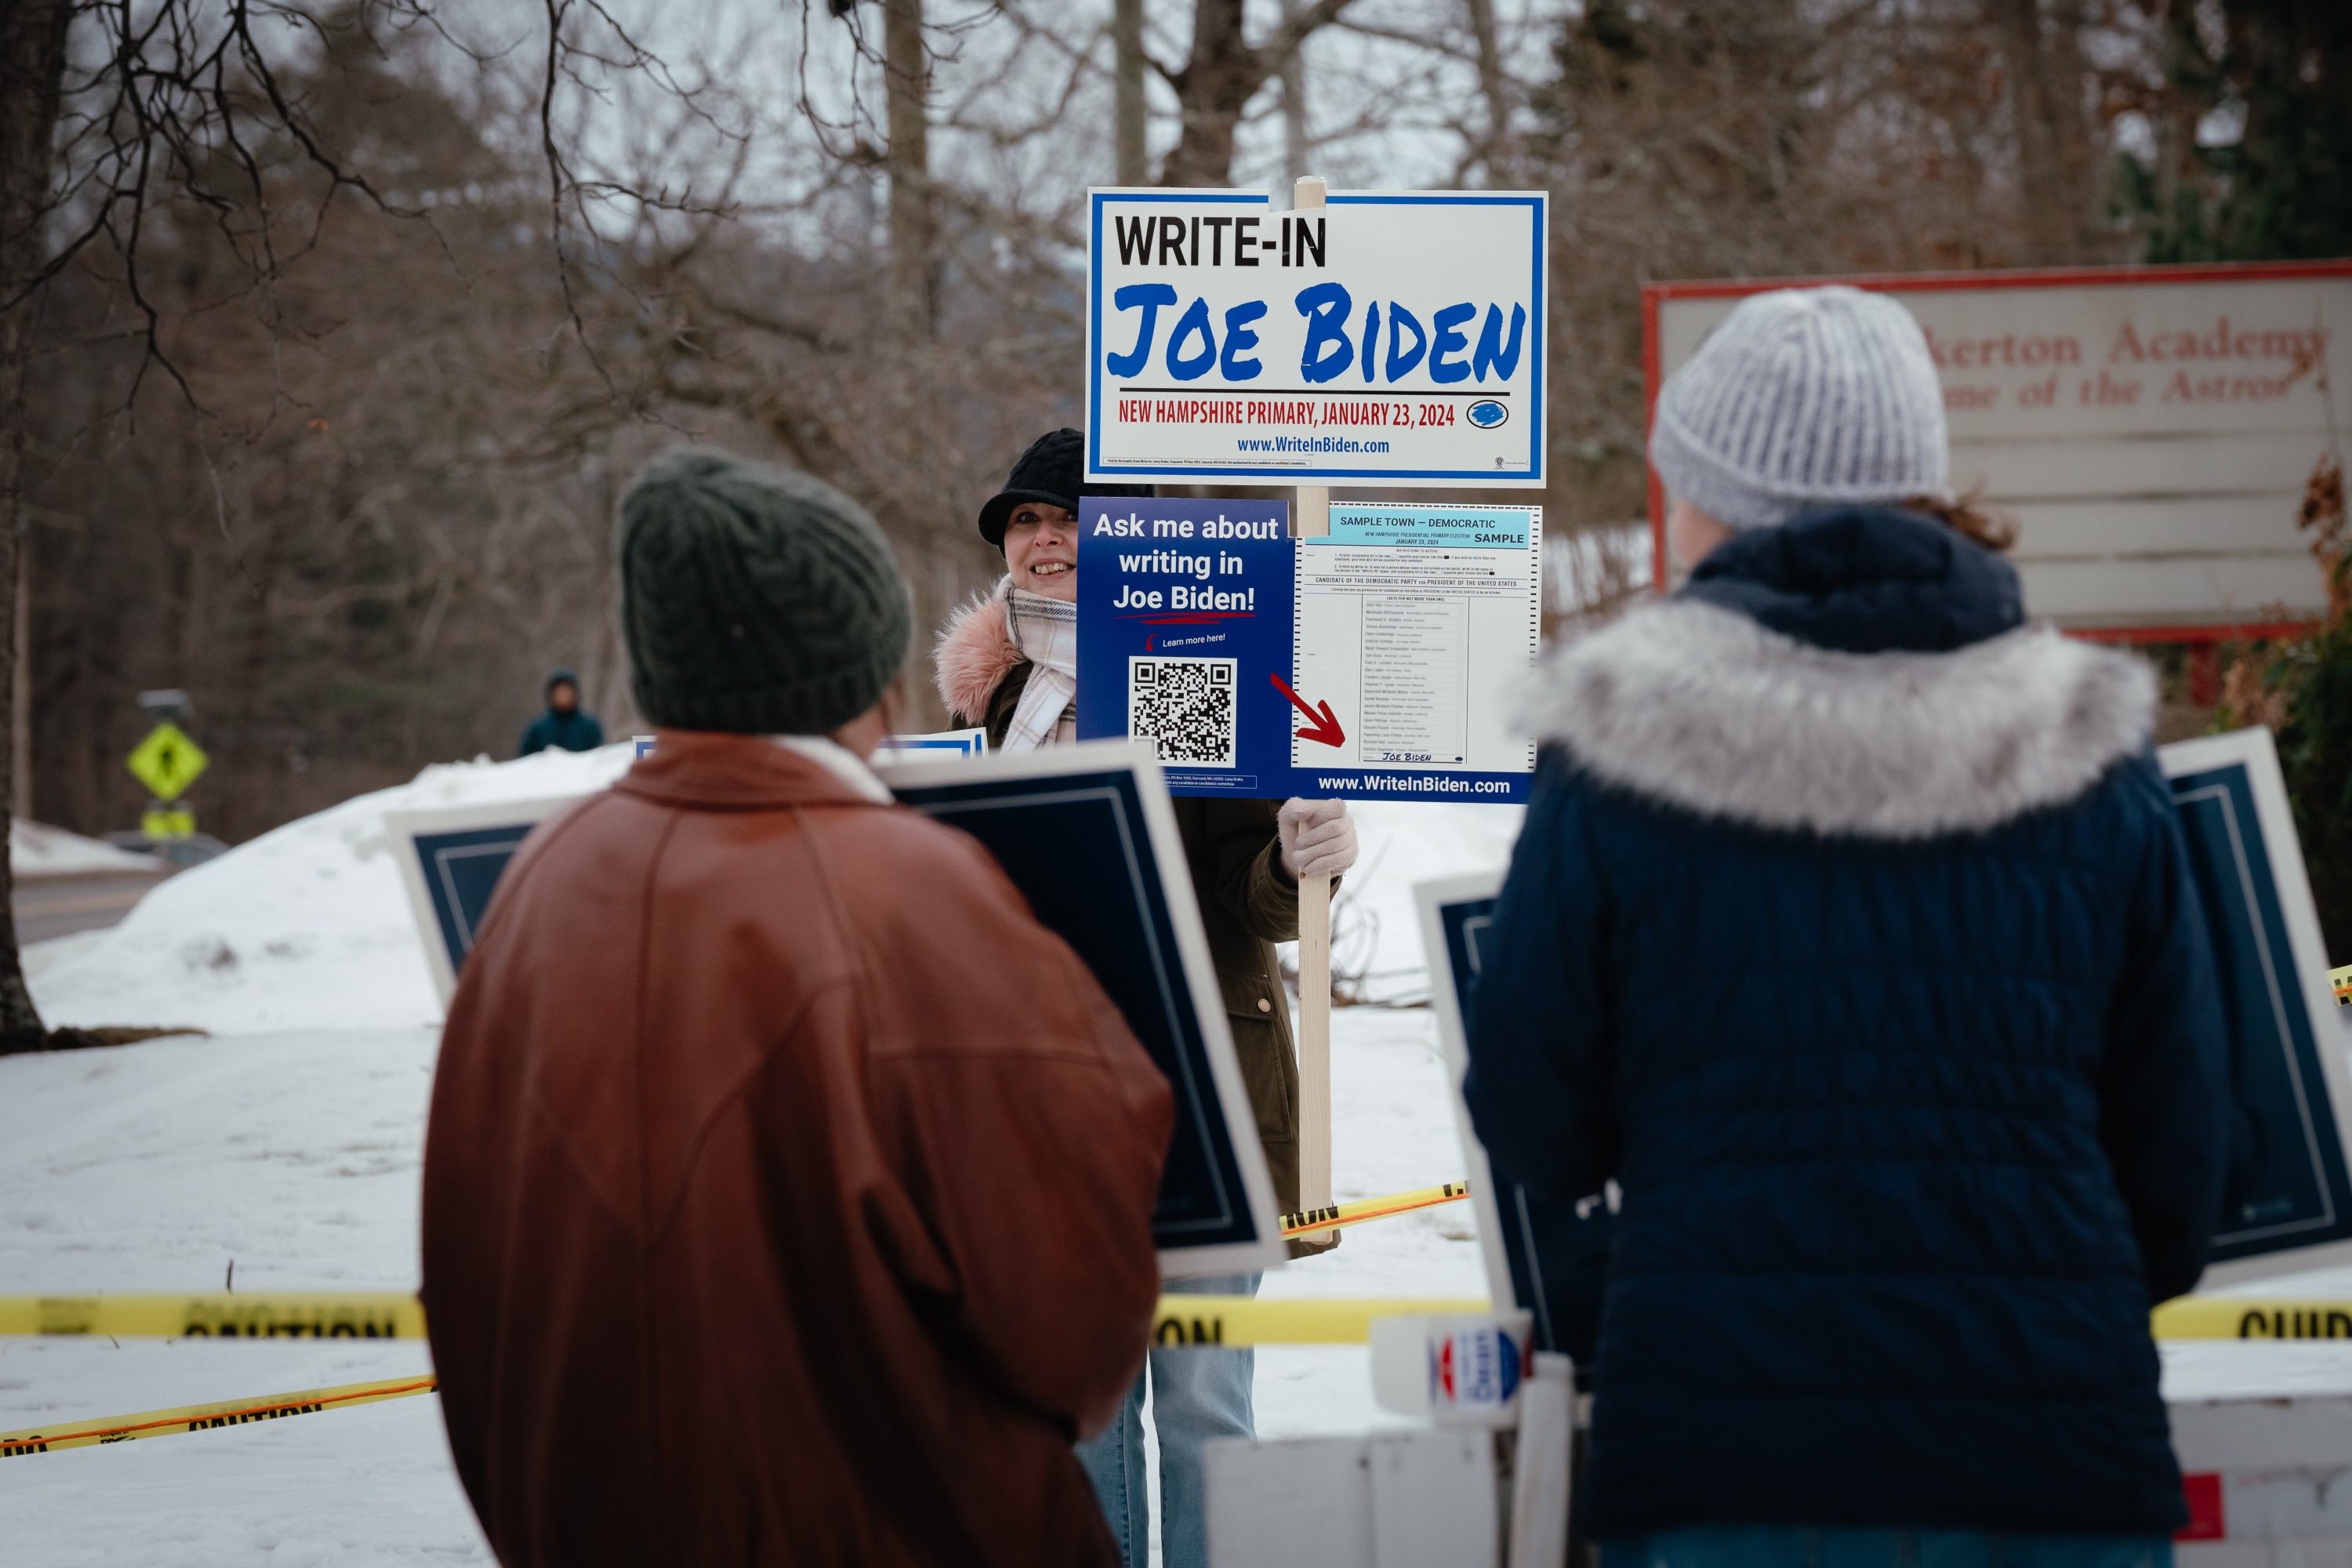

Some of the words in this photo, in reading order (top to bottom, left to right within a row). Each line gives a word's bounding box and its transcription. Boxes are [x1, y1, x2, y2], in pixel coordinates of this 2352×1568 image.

[1115, 216, 1326, 267] WRITE-IN
[1106, 283, 1267, 381] JOE
[1295, 282, 1526, 383] BIDEN
[1923, 324, 2081, 368] kerton
[2080, 369, 2143, 405] the
[1119, 399, 1153, 422] NEW
[1156, 400, 1244, 424] HAMPSHIRE
[1248, 401, 1317, 428] PRIMARY,
[1321, 402, 1389, 426] JANUARY
[1393, 404, 1416, 429] 23,
[1418, 405, 1454, 426] 2024
[1237, 437, 1389, 454] www.WriteInBiden.com
[1093, 513, 1145, 537] Ask
[1153, 518, 1194, 539] me
[1202, 515, 1279, 539] about
[1340, 517, 1382, 526] SAMPLE
[1385, 517, 1415, 527] TOWN
[1428, 518, 1496, 528] DEMOCRATIC
[1474, 533, 1524, 544] SAMPLE
[1119, 550, 1210, 579] writing
[1220, 551, 1243, 574] in
[1113, 585, 1163, 609] Joe
[1171, 586, 1254, 611] Biden!
[1163, 639, 1185, 648] Learn
[1186, 637, 1205, 645] more
[1206, 633, 1225, 644] here!
[1405, 753, 1432, 761] BIDEN
[1319, 775, 1511, 793] www.WriteInBiden.com
